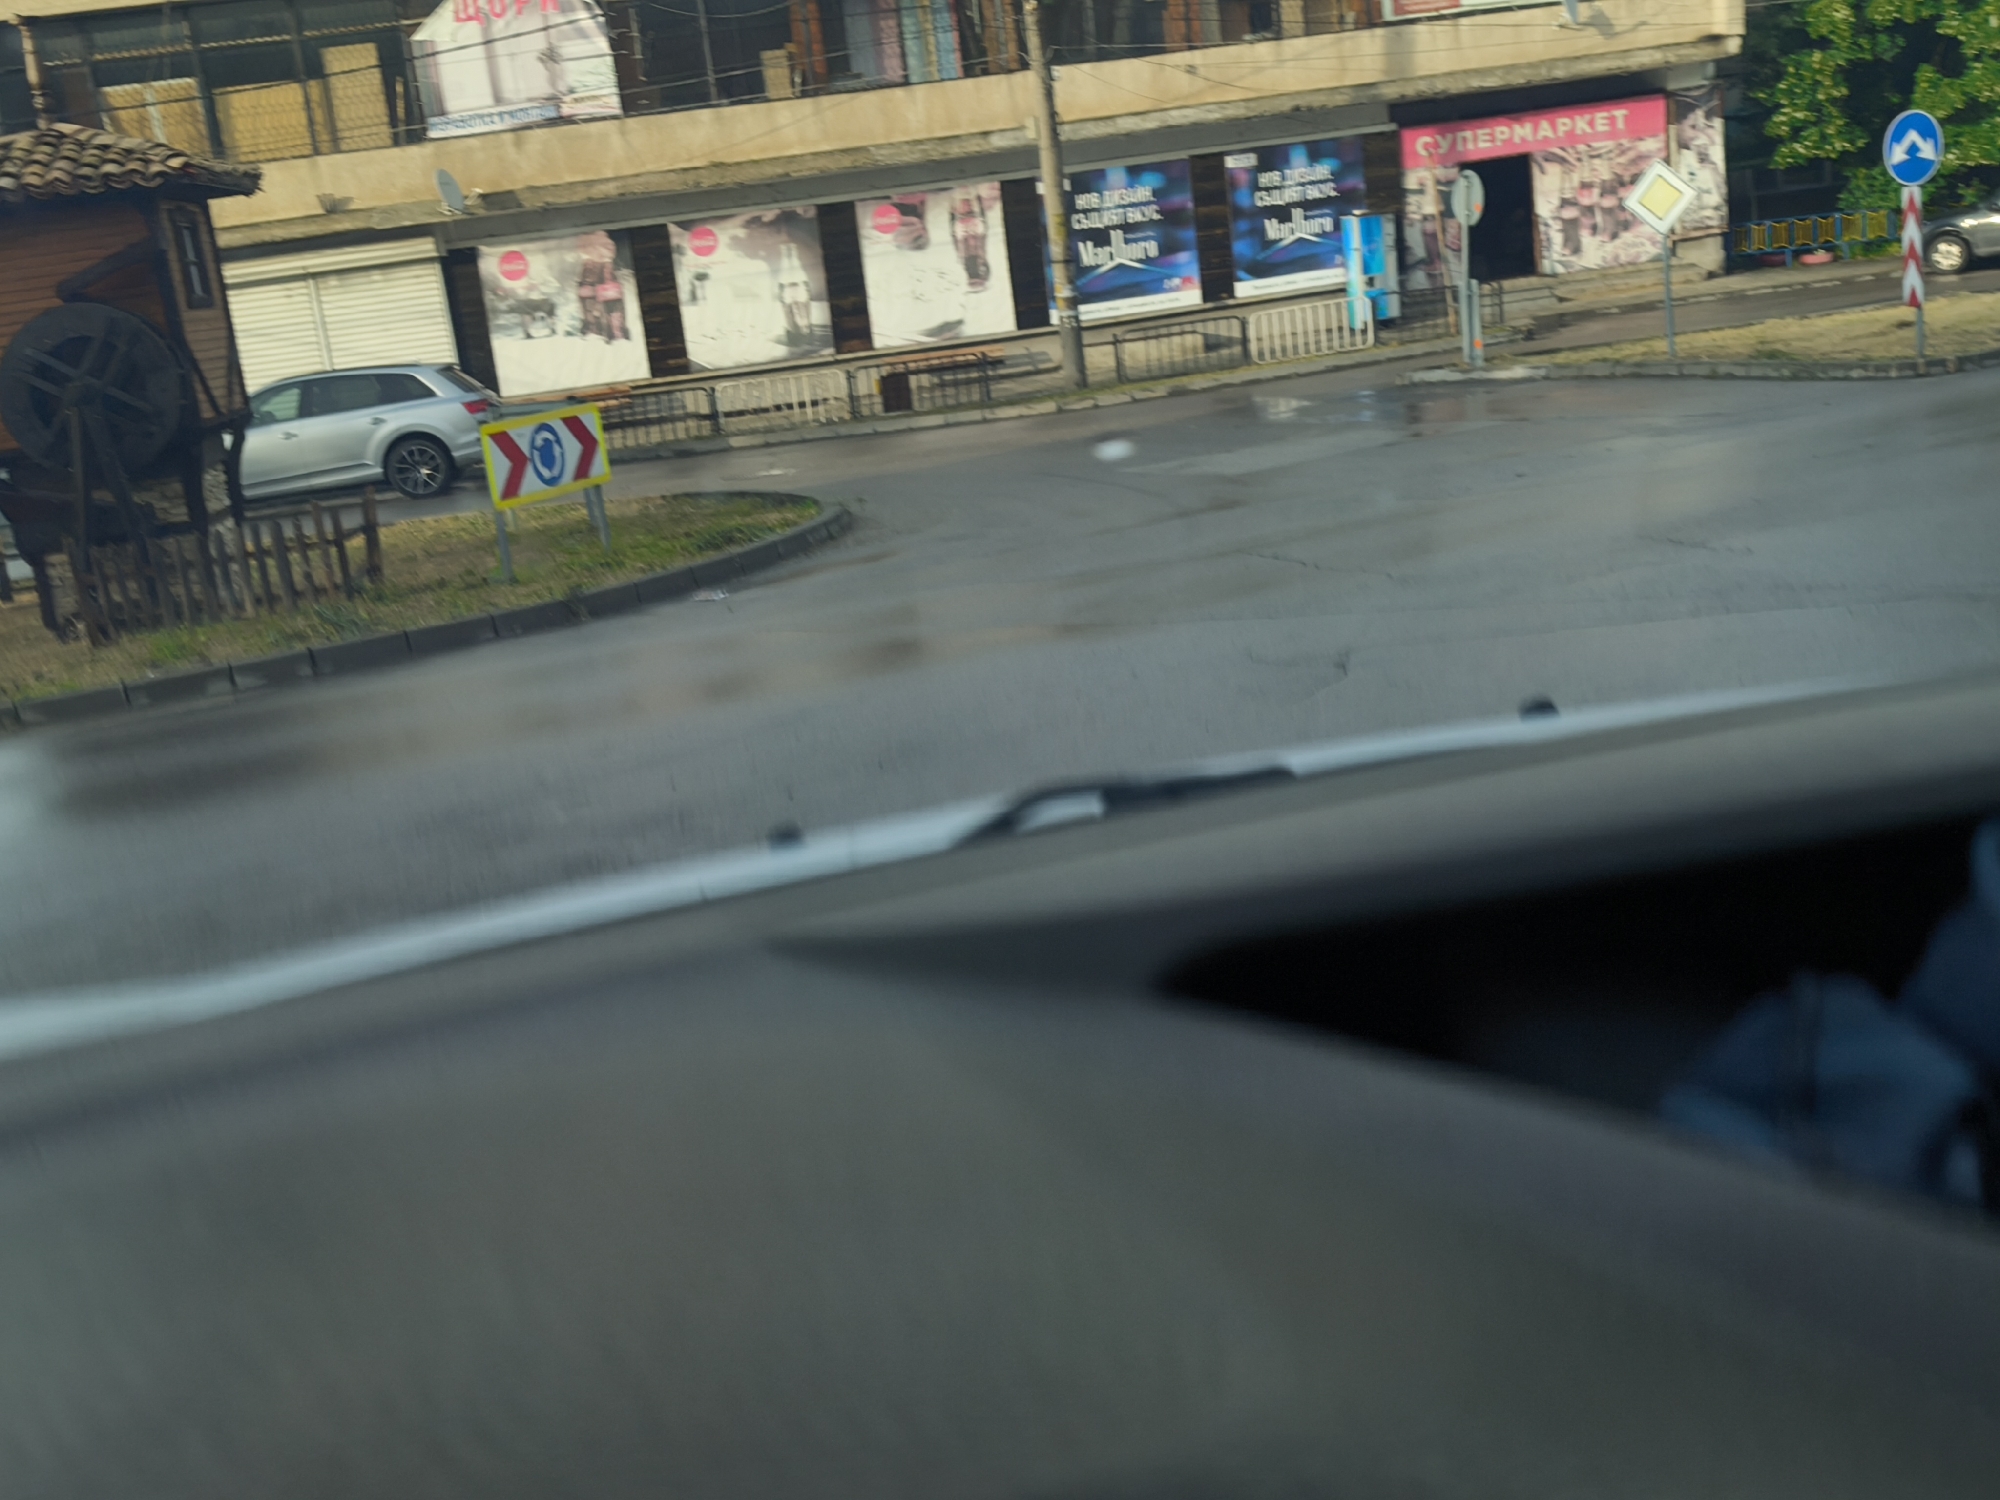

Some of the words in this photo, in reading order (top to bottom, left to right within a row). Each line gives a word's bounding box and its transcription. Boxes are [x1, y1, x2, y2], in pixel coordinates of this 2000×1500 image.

[1415, 109, 1630, 157] СУПЕРМАРКЕТ
[1264, 208, 1334, 241] Marlboro
[1077, 229, 1159, 267] Marlboro
